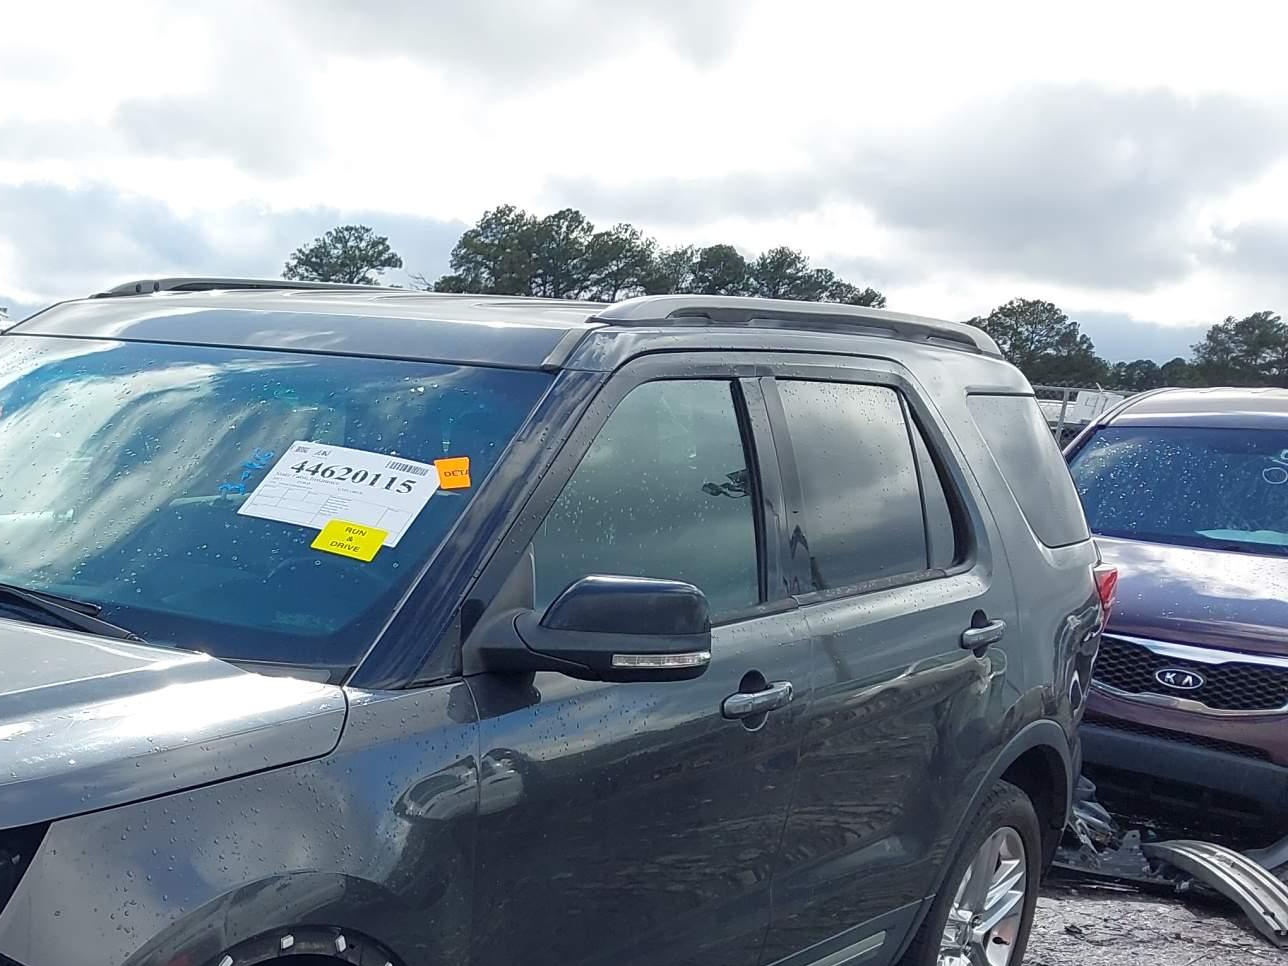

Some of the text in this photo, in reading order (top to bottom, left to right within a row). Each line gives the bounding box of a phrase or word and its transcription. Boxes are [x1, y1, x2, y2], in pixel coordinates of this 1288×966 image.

[290, 460, 417, 494] 44620115
[344, 526, 367, 536] RUN
[329, 541, 360, 552] DRIVE
[1164, 672, 1193, 687] KA
